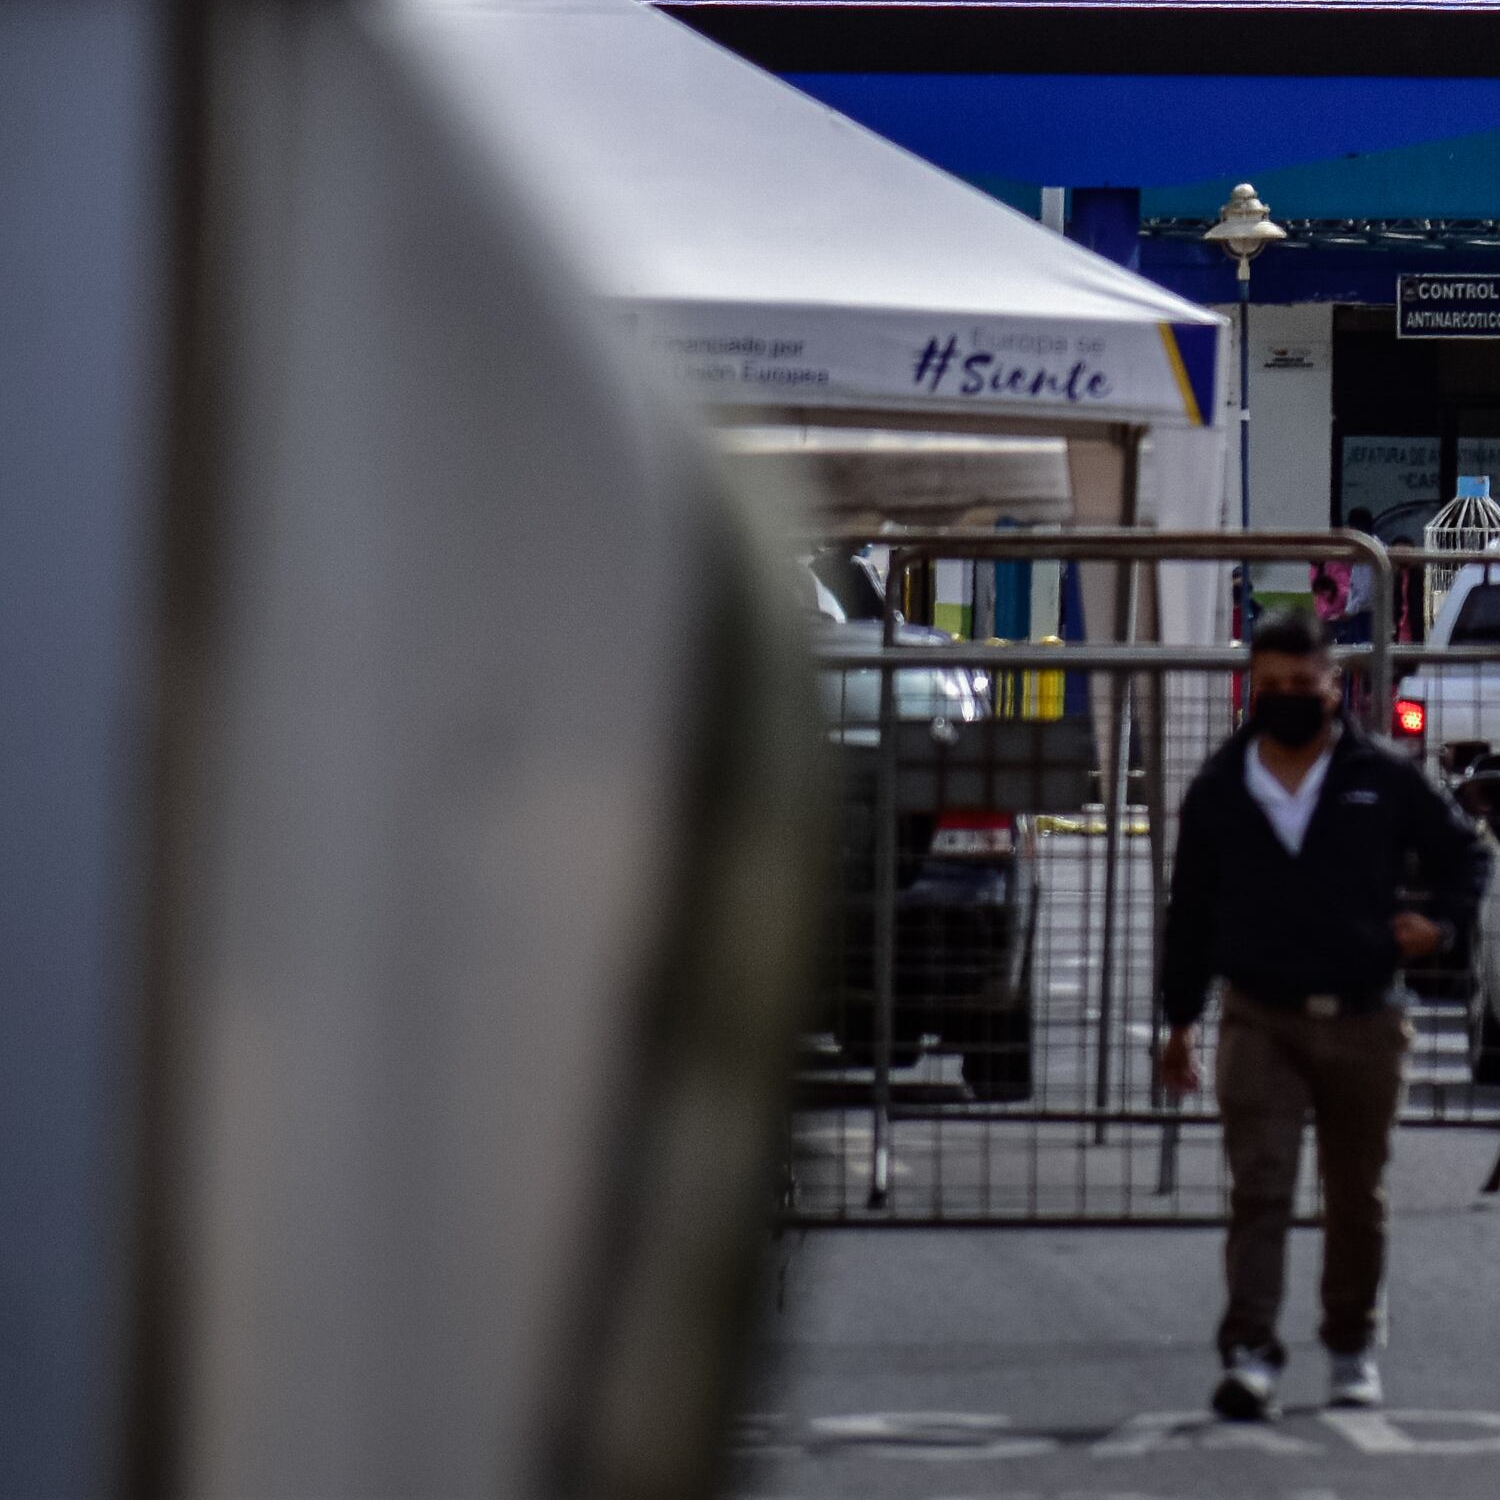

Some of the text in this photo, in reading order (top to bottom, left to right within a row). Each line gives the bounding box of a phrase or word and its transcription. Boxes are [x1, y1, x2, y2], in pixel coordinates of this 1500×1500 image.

[1418, 281, 1500, 301] CONTROL
[970, 326, 1069, 355] Europa
[911, 334, 1114, 402] #Siente
